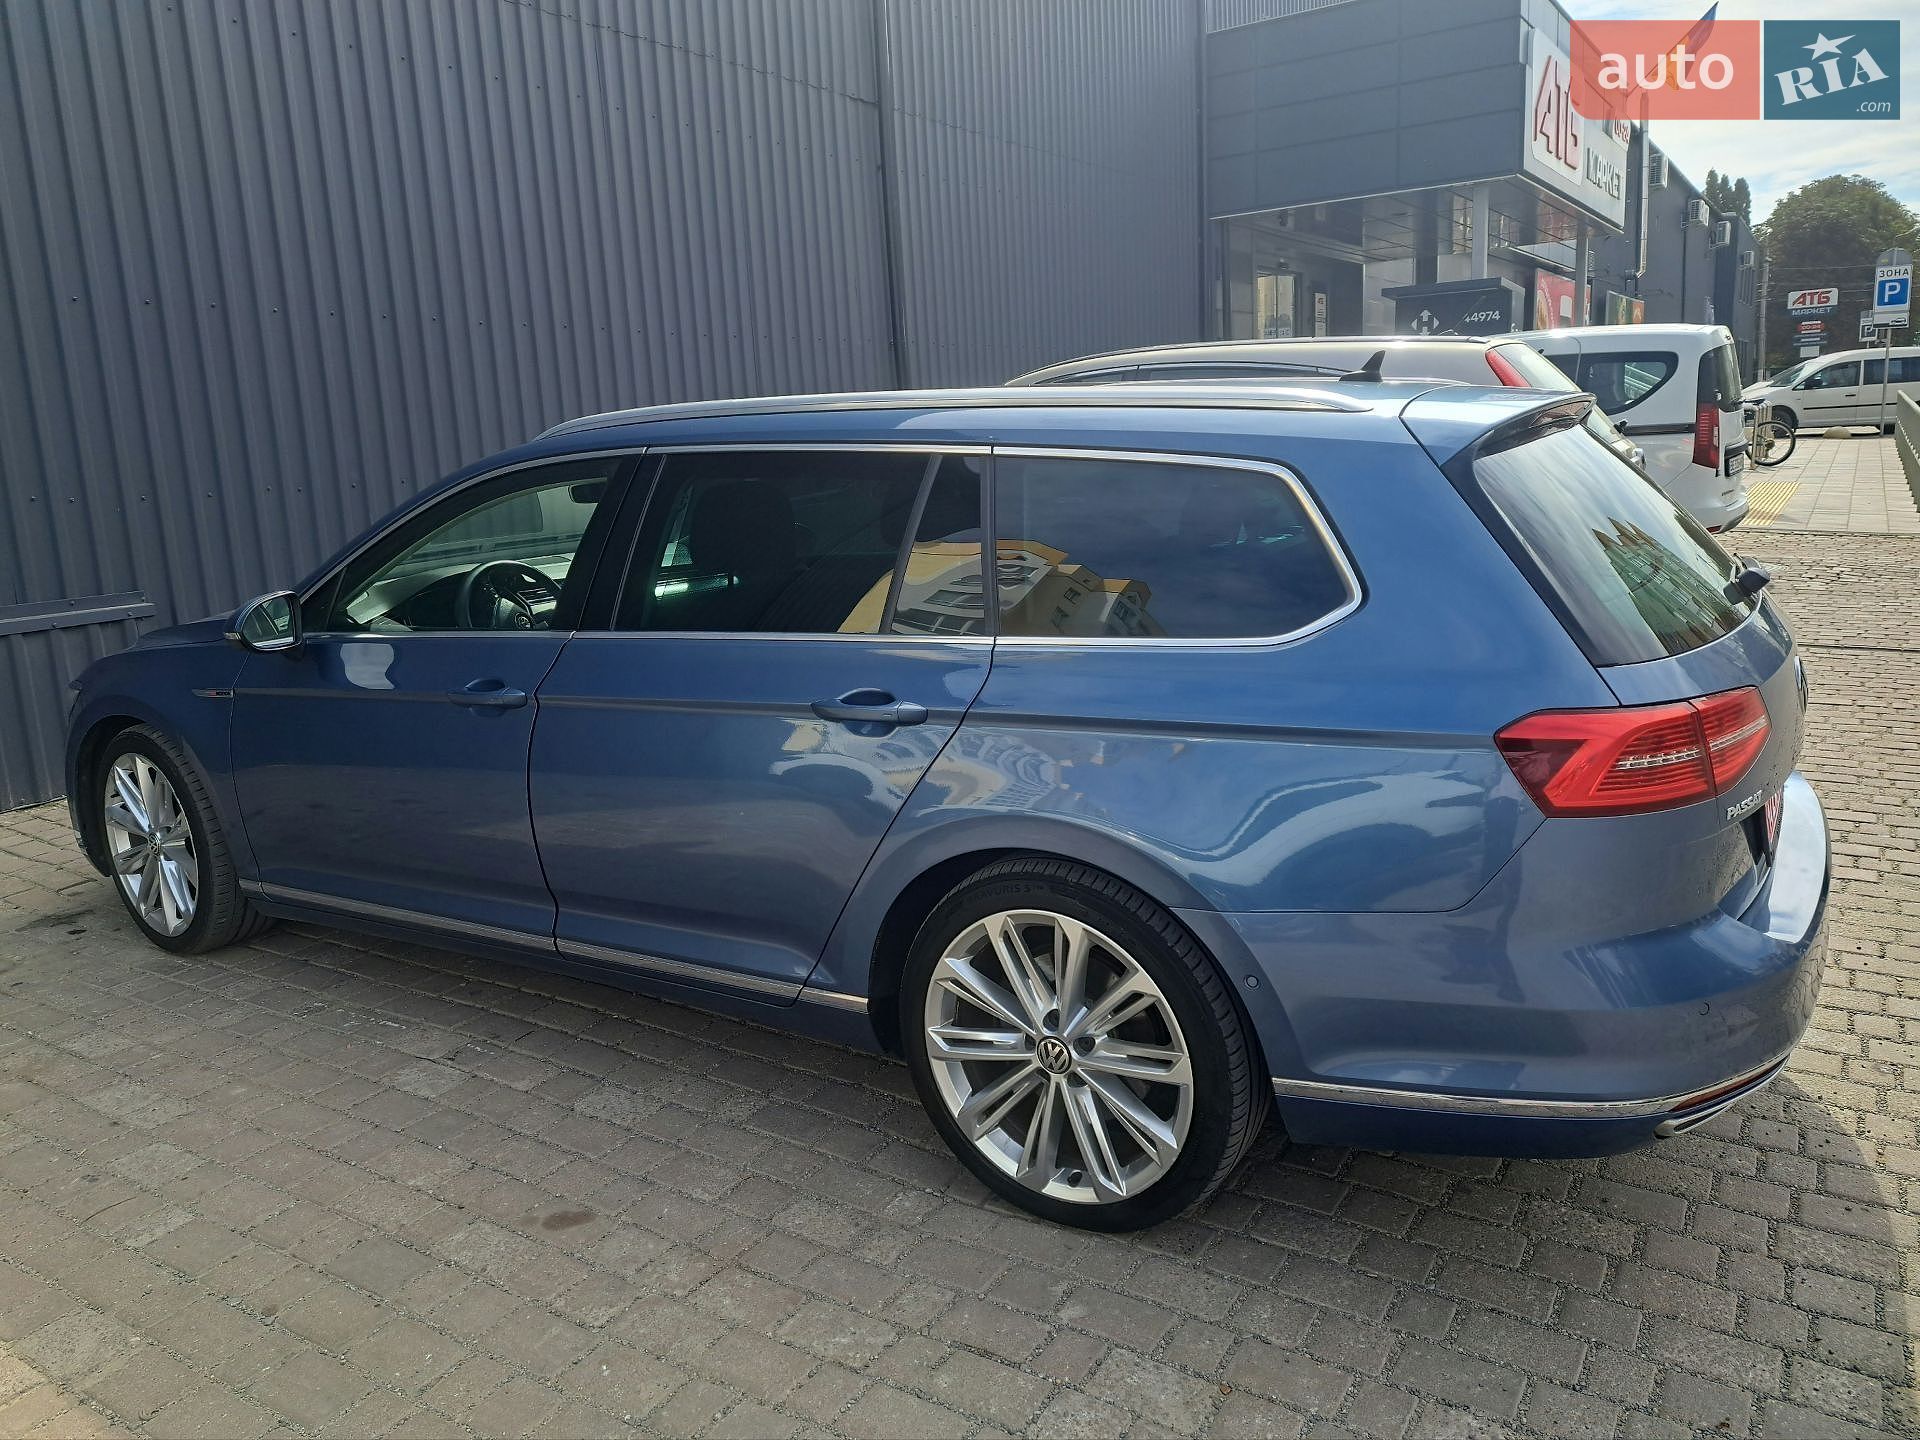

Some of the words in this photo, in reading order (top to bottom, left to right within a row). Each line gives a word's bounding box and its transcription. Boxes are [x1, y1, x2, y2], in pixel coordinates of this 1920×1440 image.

[1879, 268, 1909, 278] ЗОНА
[1792, 290, 1832, 306] АТБ
[1792, 307, 1832, 316] МАРКЕТ
[1727, 789, 1762, 820] PASSAT
